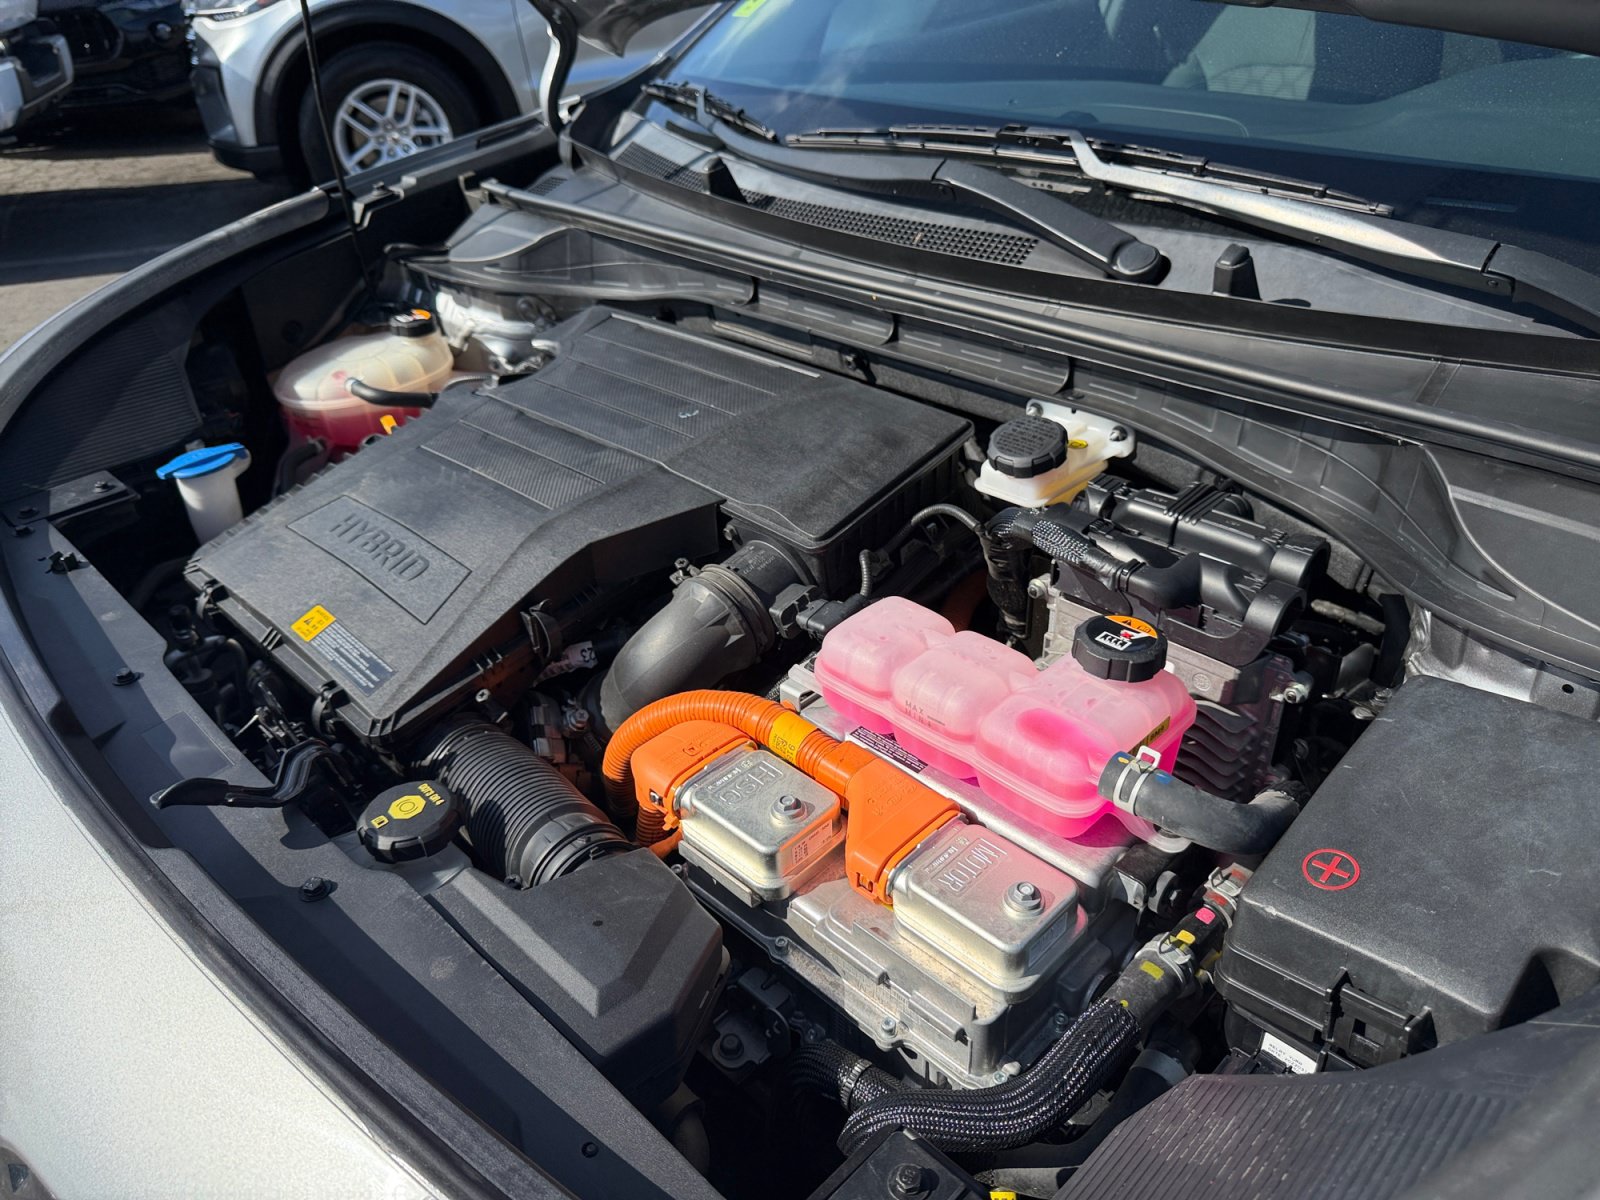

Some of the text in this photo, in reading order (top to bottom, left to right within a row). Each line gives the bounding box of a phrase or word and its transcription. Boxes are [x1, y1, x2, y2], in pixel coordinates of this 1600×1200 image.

[329, 512, 431, 582] HYBRID
[905, 700, 924, 714] MAX
[719, 766, 777, 805] HSG
[937, 843, 993, 893] MOTOR
